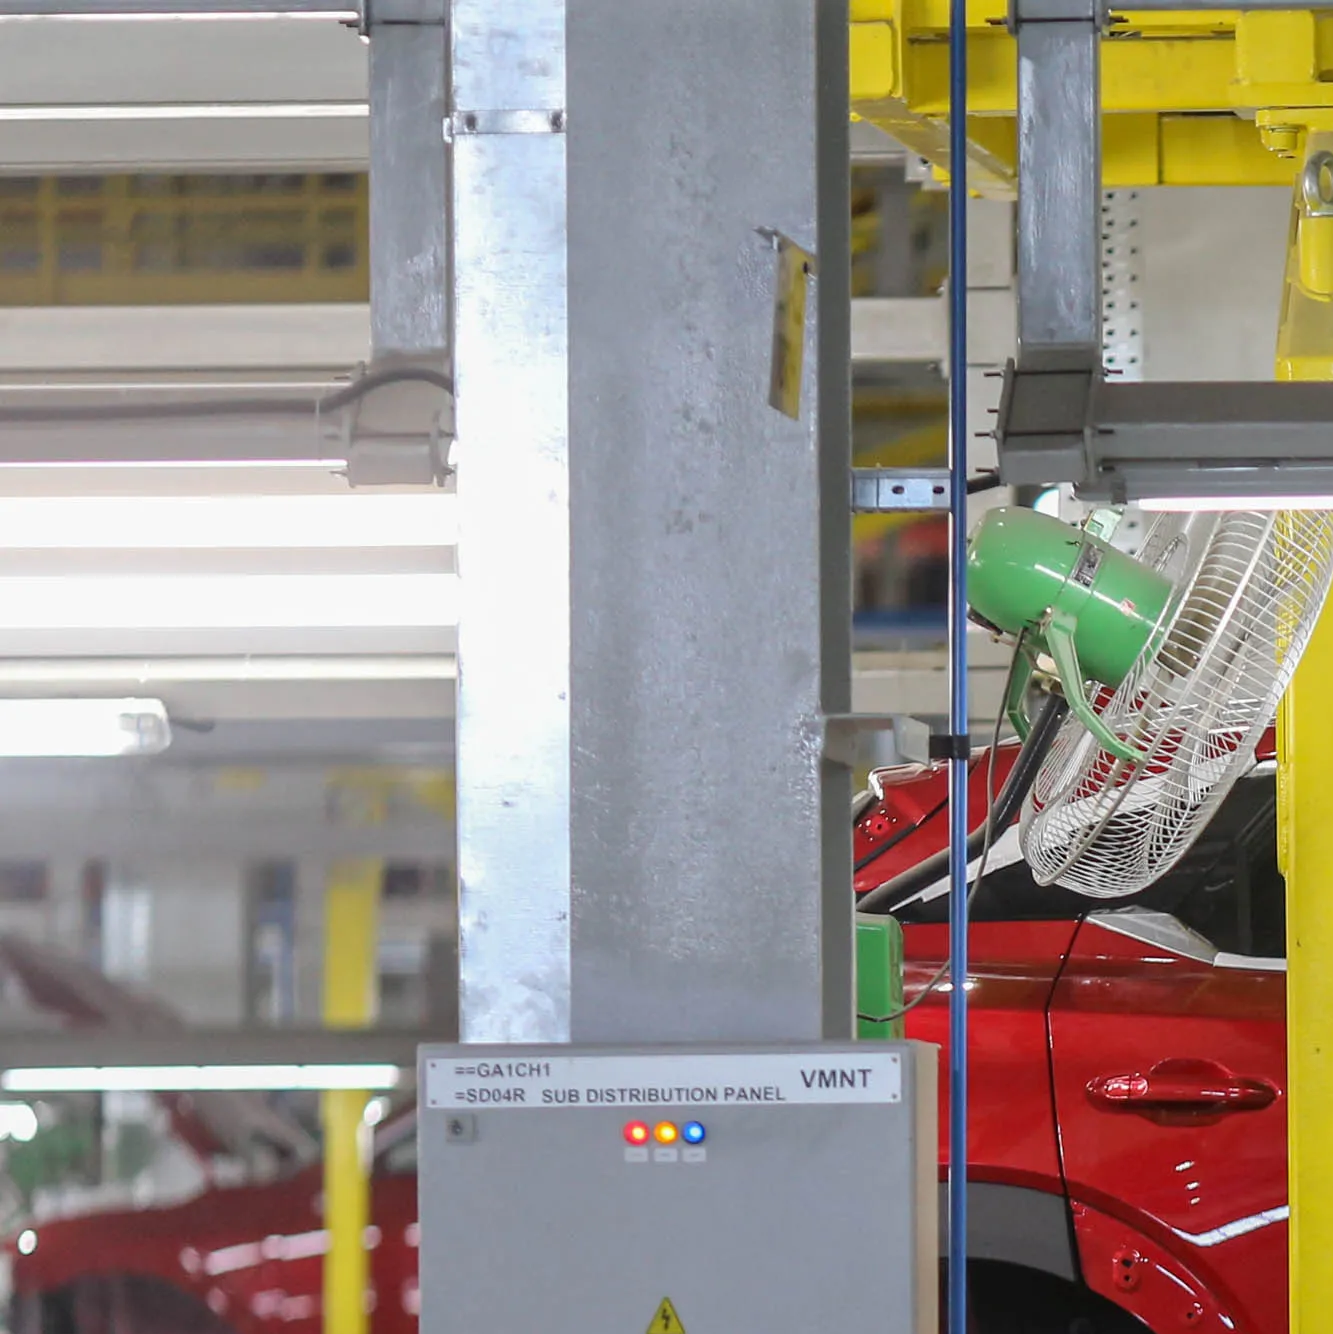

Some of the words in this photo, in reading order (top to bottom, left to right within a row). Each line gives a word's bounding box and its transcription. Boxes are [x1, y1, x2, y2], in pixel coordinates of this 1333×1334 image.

[454, 1062, 550, 1078] ==GA1CH1
[800, 1068, 872, 1089] VMNT
[541, 1088, 580, 1104] SUB
[586, 1086, 718, 1104] DISTRIBUTION
[723, 1085, 786, 1102] PANEL
